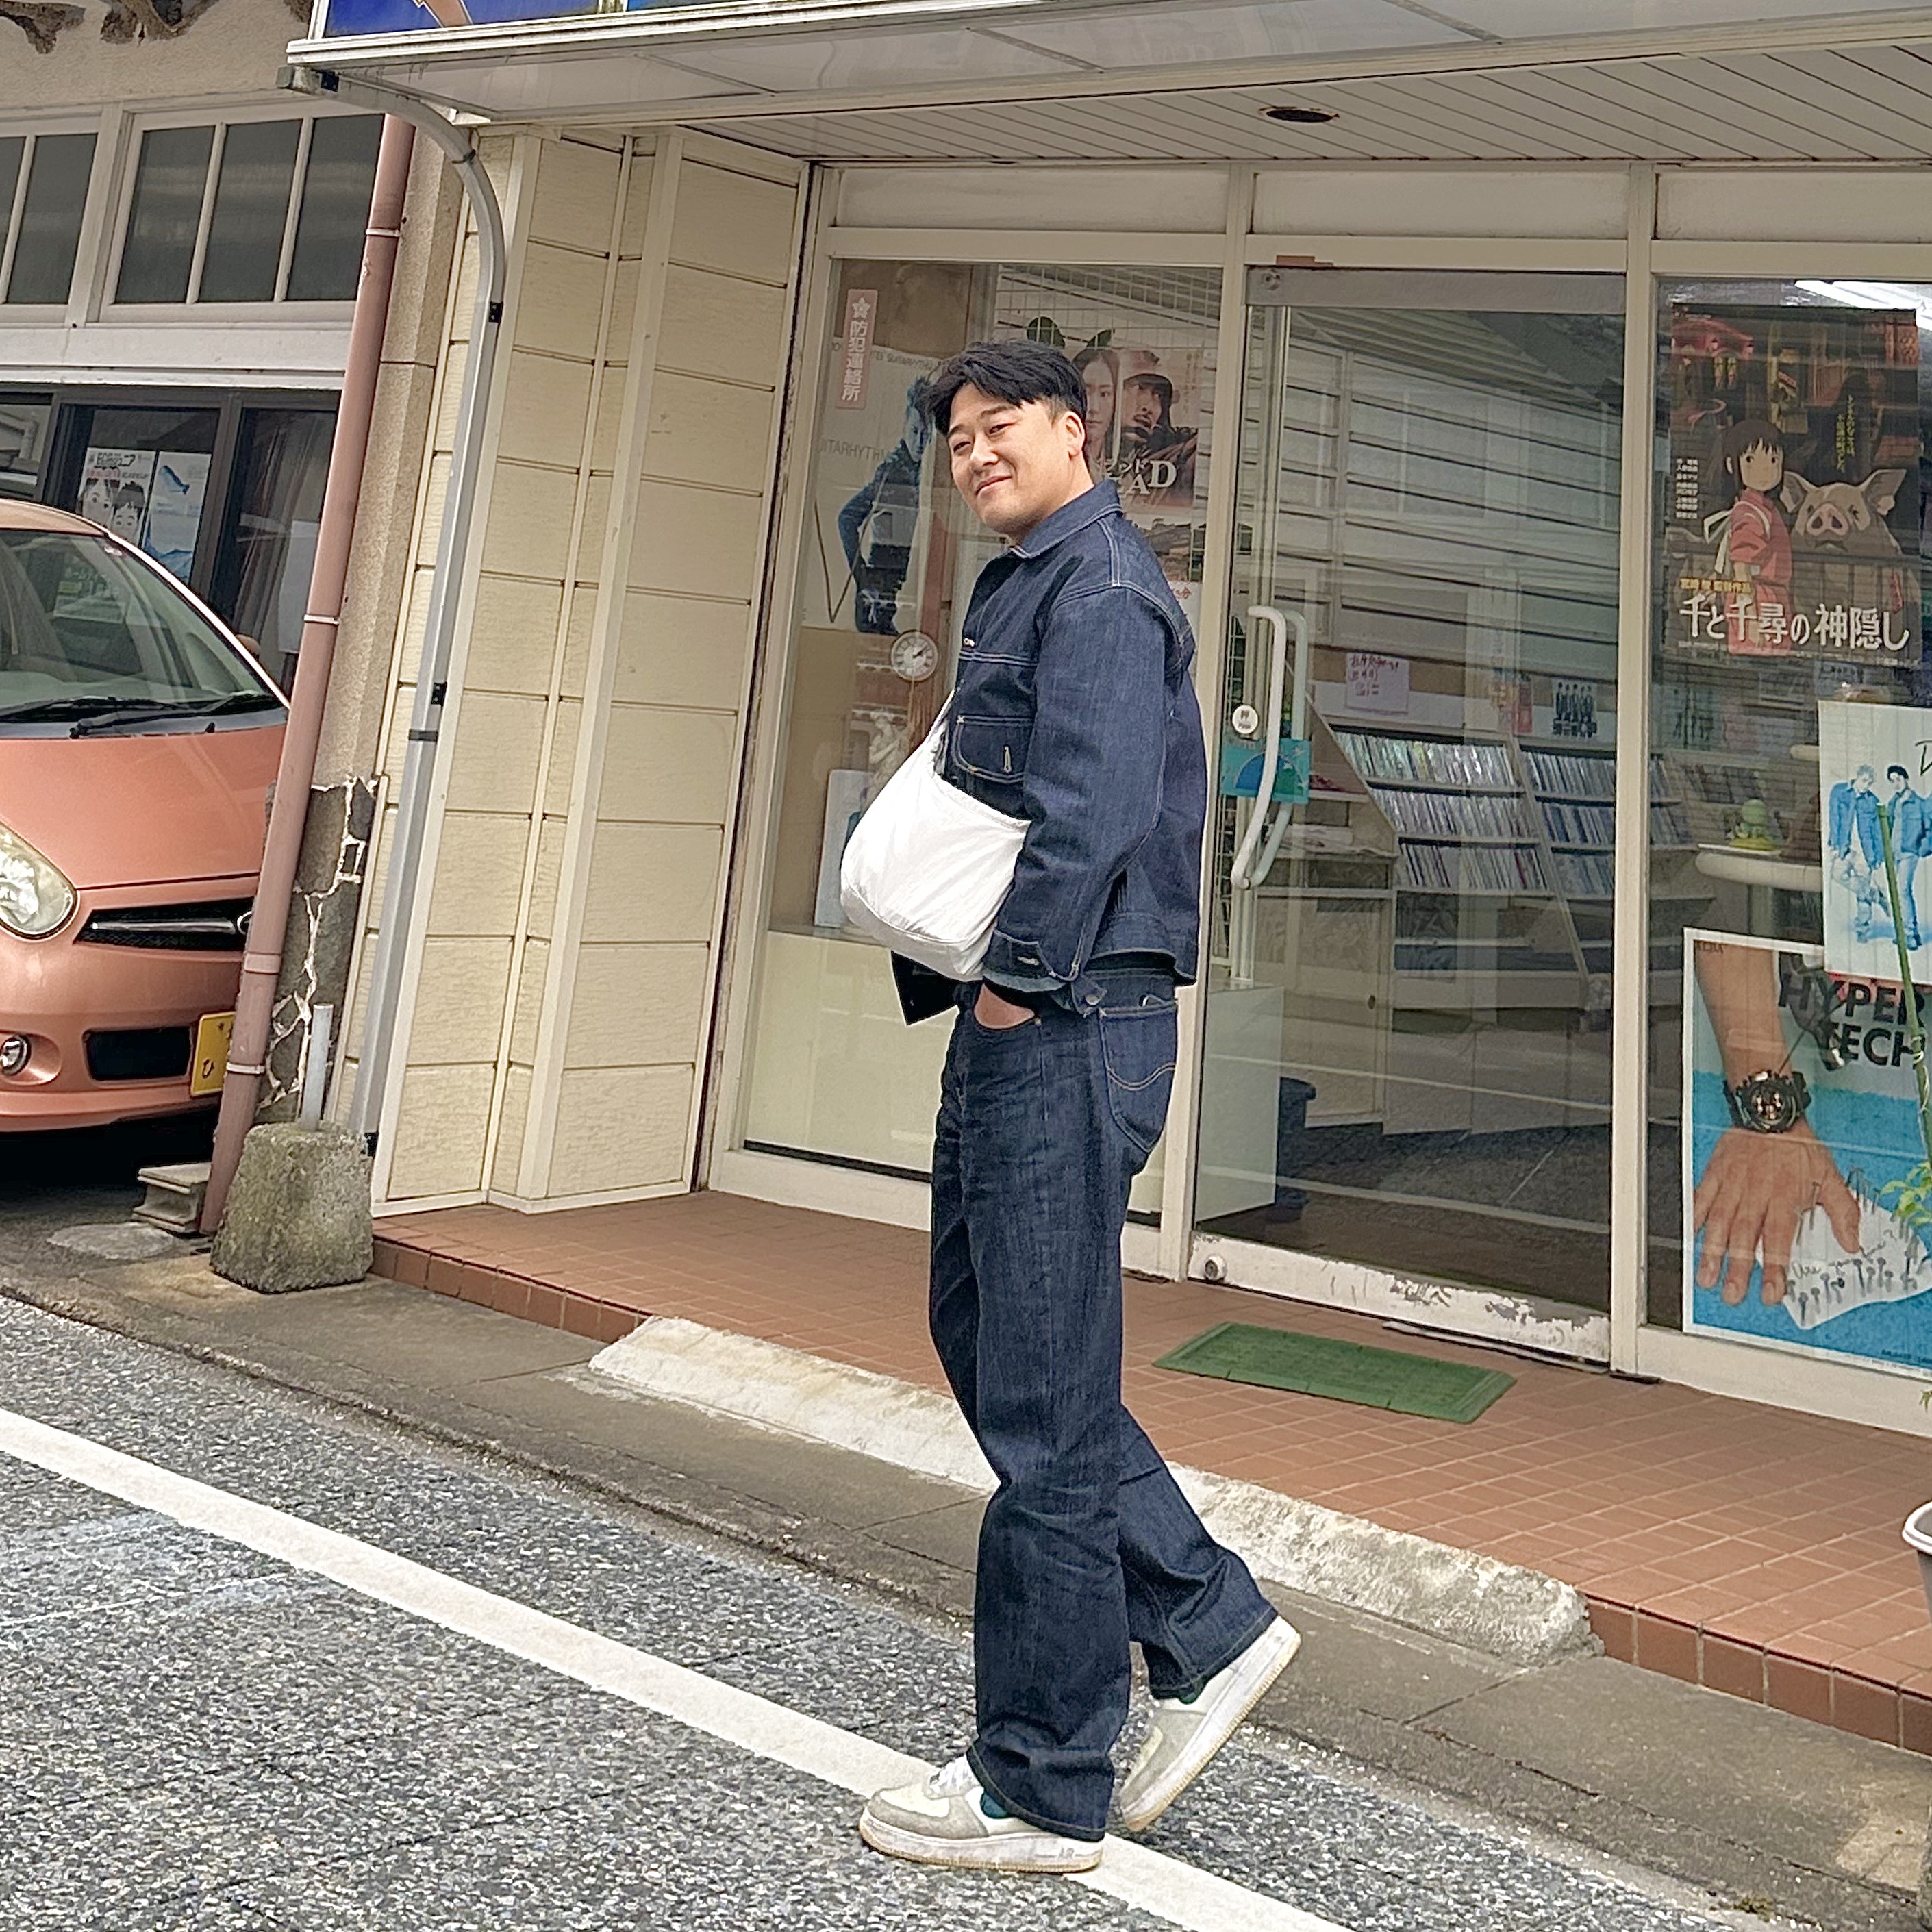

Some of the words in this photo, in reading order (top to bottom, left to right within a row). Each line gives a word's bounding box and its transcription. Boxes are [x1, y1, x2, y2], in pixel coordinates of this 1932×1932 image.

[842, 321, 868, 401] 防犯連絡所
[1679, 593, 1909, 651] 千と千尋の神隠し
[1779, 973, 1925, 1027] HYPER
[1818, 1019, 1926, 1070] ECH
